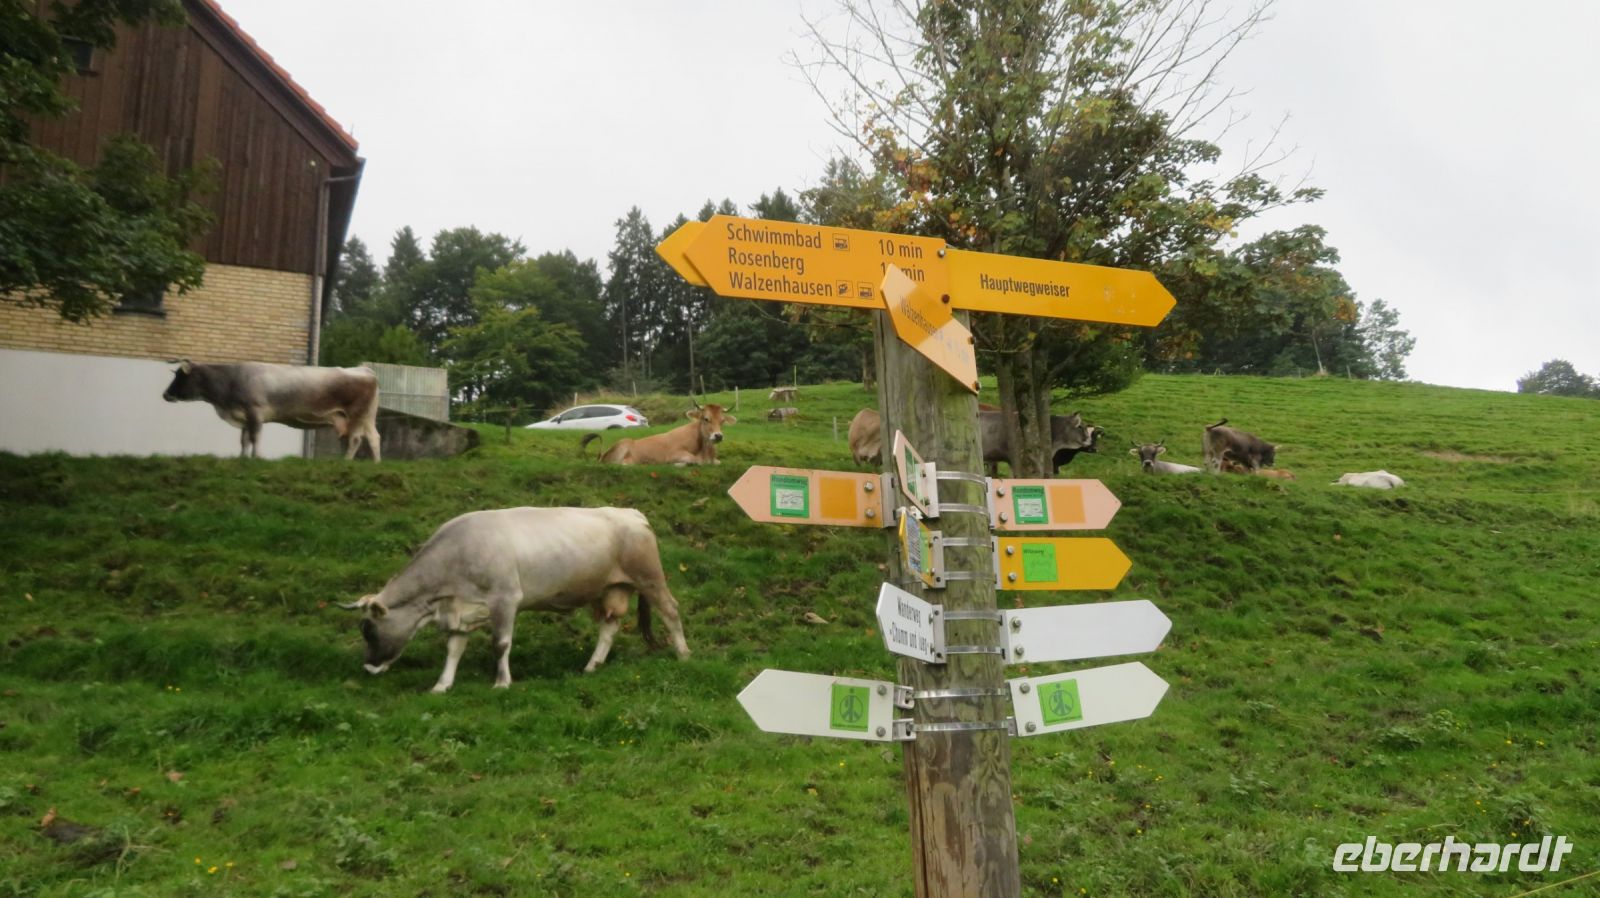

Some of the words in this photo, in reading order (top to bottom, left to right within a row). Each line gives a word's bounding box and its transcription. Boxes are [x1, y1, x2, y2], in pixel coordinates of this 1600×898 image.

[727, 223, 822, 249] Schwimmbad
[878, 239, 895, 257] 10
[899, 242, 923, 259] min
[728, 247, 805, 275] Rosenberg
[901, 264, 925, 282] min
[729, 272, 833, 297] Walzenhausen
[980, 273, 1070, 298] Hauptwegweiser
[896, 595, 921, 628] Wanderweg
